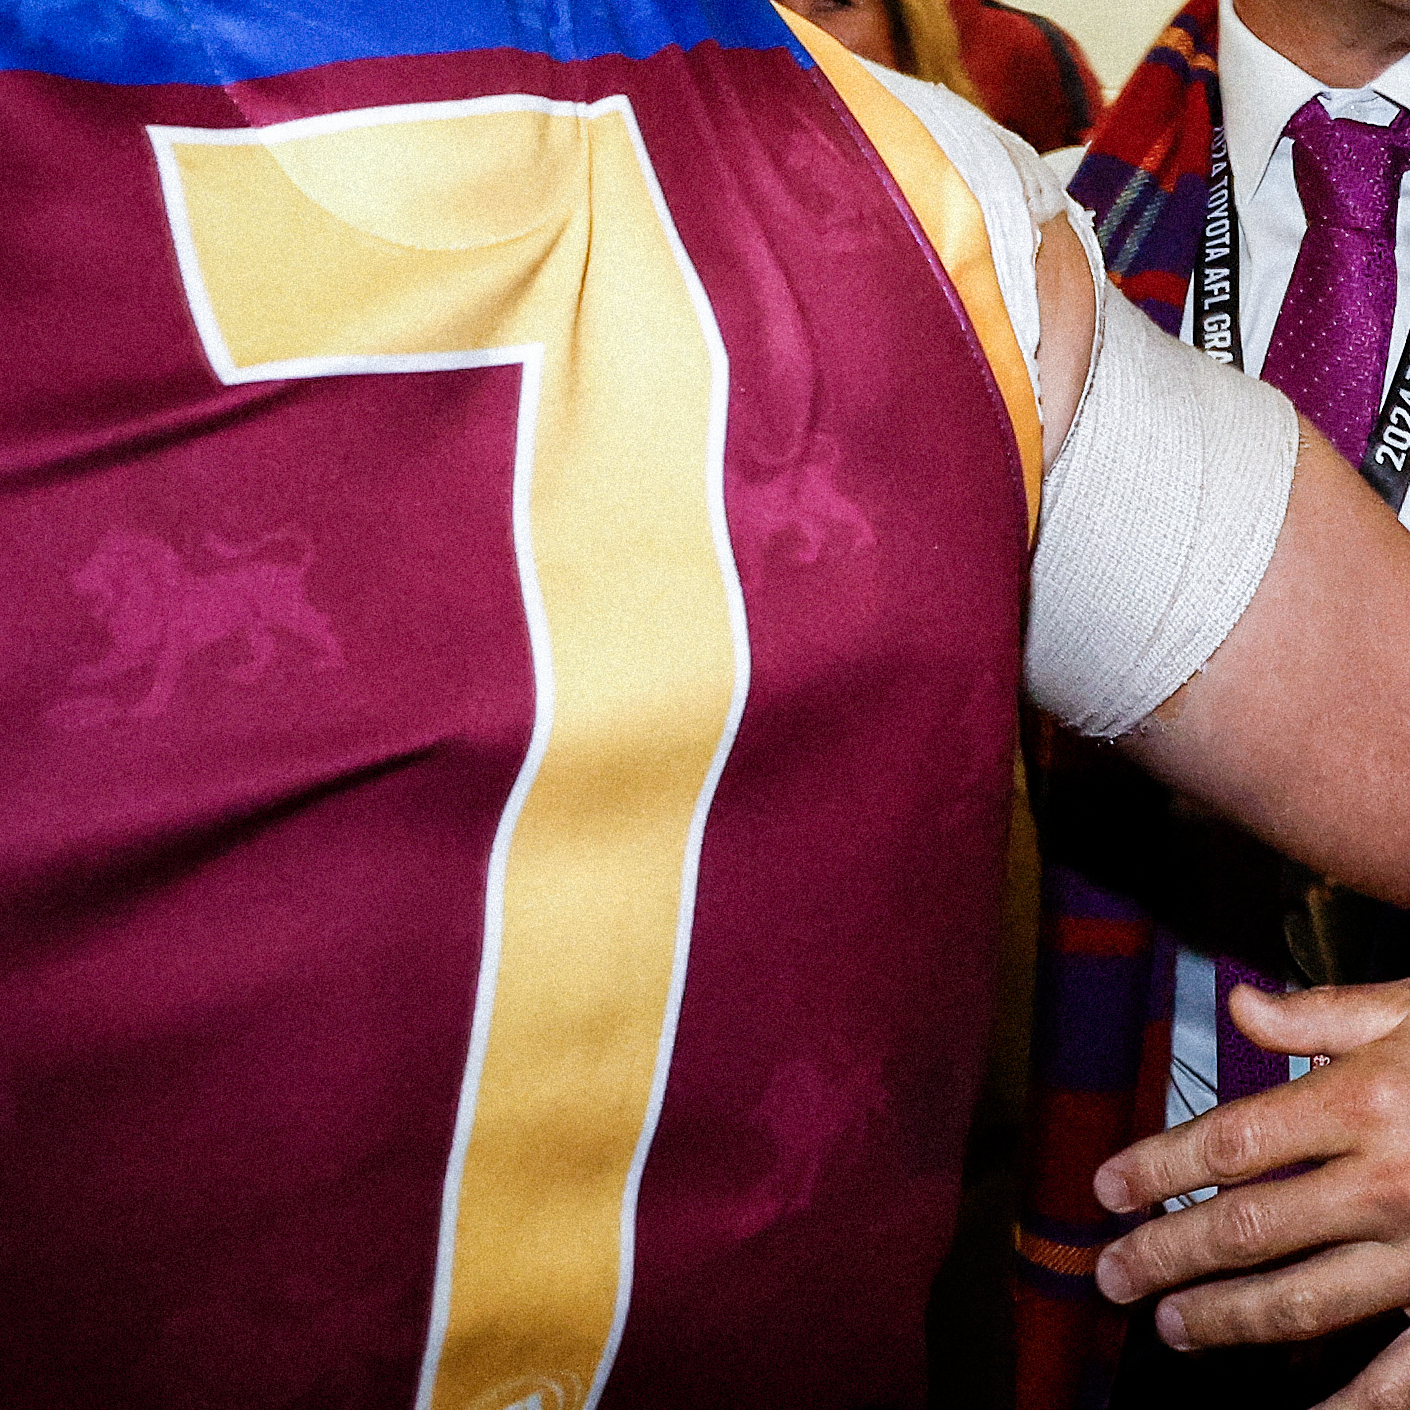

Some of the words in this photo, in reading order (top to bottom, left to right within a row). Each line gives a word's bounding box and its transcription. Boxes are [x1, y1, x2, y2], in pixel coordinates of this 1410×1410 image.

[1205, 175, 1231, 263] TOYOTA
[1203, 267, 1231, 311] AFL
[146, 92, 752, 1410] 7
